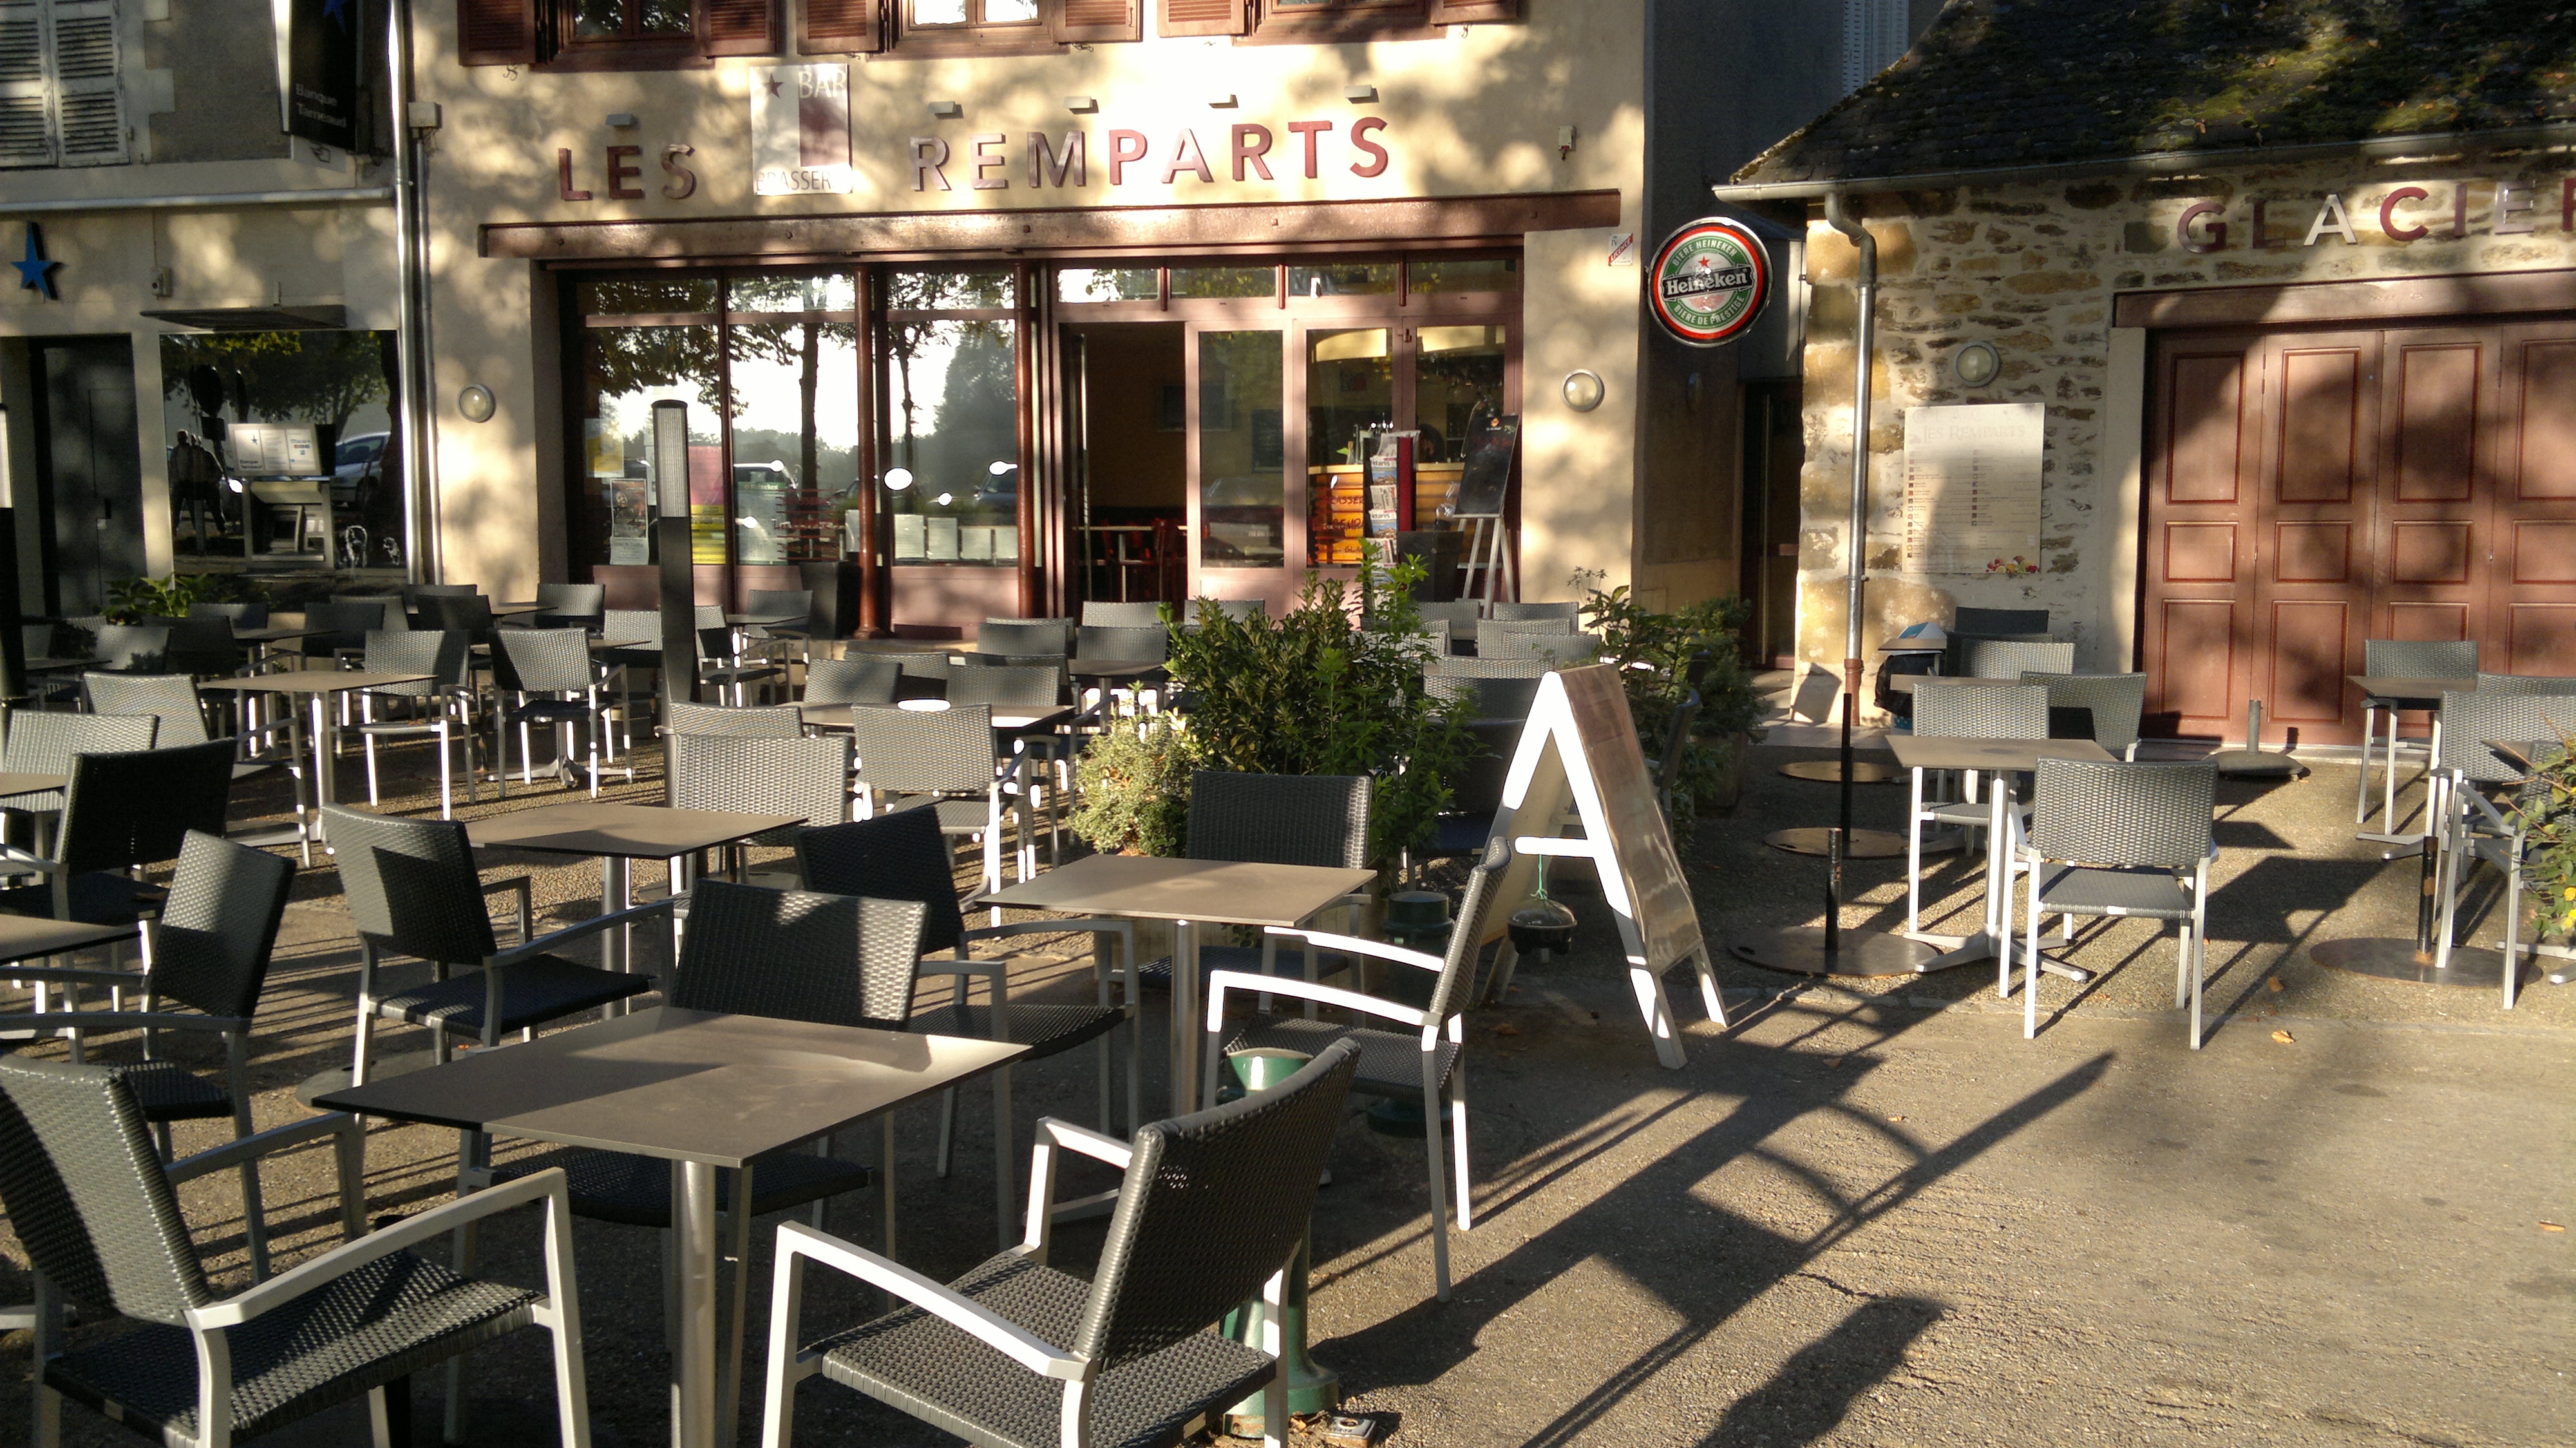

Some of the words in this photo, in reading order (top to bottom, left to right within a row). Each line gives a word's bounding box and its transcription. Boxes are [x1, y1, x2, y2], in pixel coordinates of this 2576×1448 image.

[295, 83, 337, 107] Banque
[798, 70, 848, 99] BAR
[557, 143, 696, 201] LES
[909, 117, 1389, 192] REMPARTS
[1611, 237, 1631, 262] LICENCE
[1672, 245, 1694, 266] BIERE
[1696, 240, 1738, 257] HEINEKEN
[1666, 269, 1747, 296] Heineken
[1674, 304, 1696, 324] BIERE
[1698, 316, 1708, 325] DE
[1710, 295, 1745, 325] PRESTIGE
